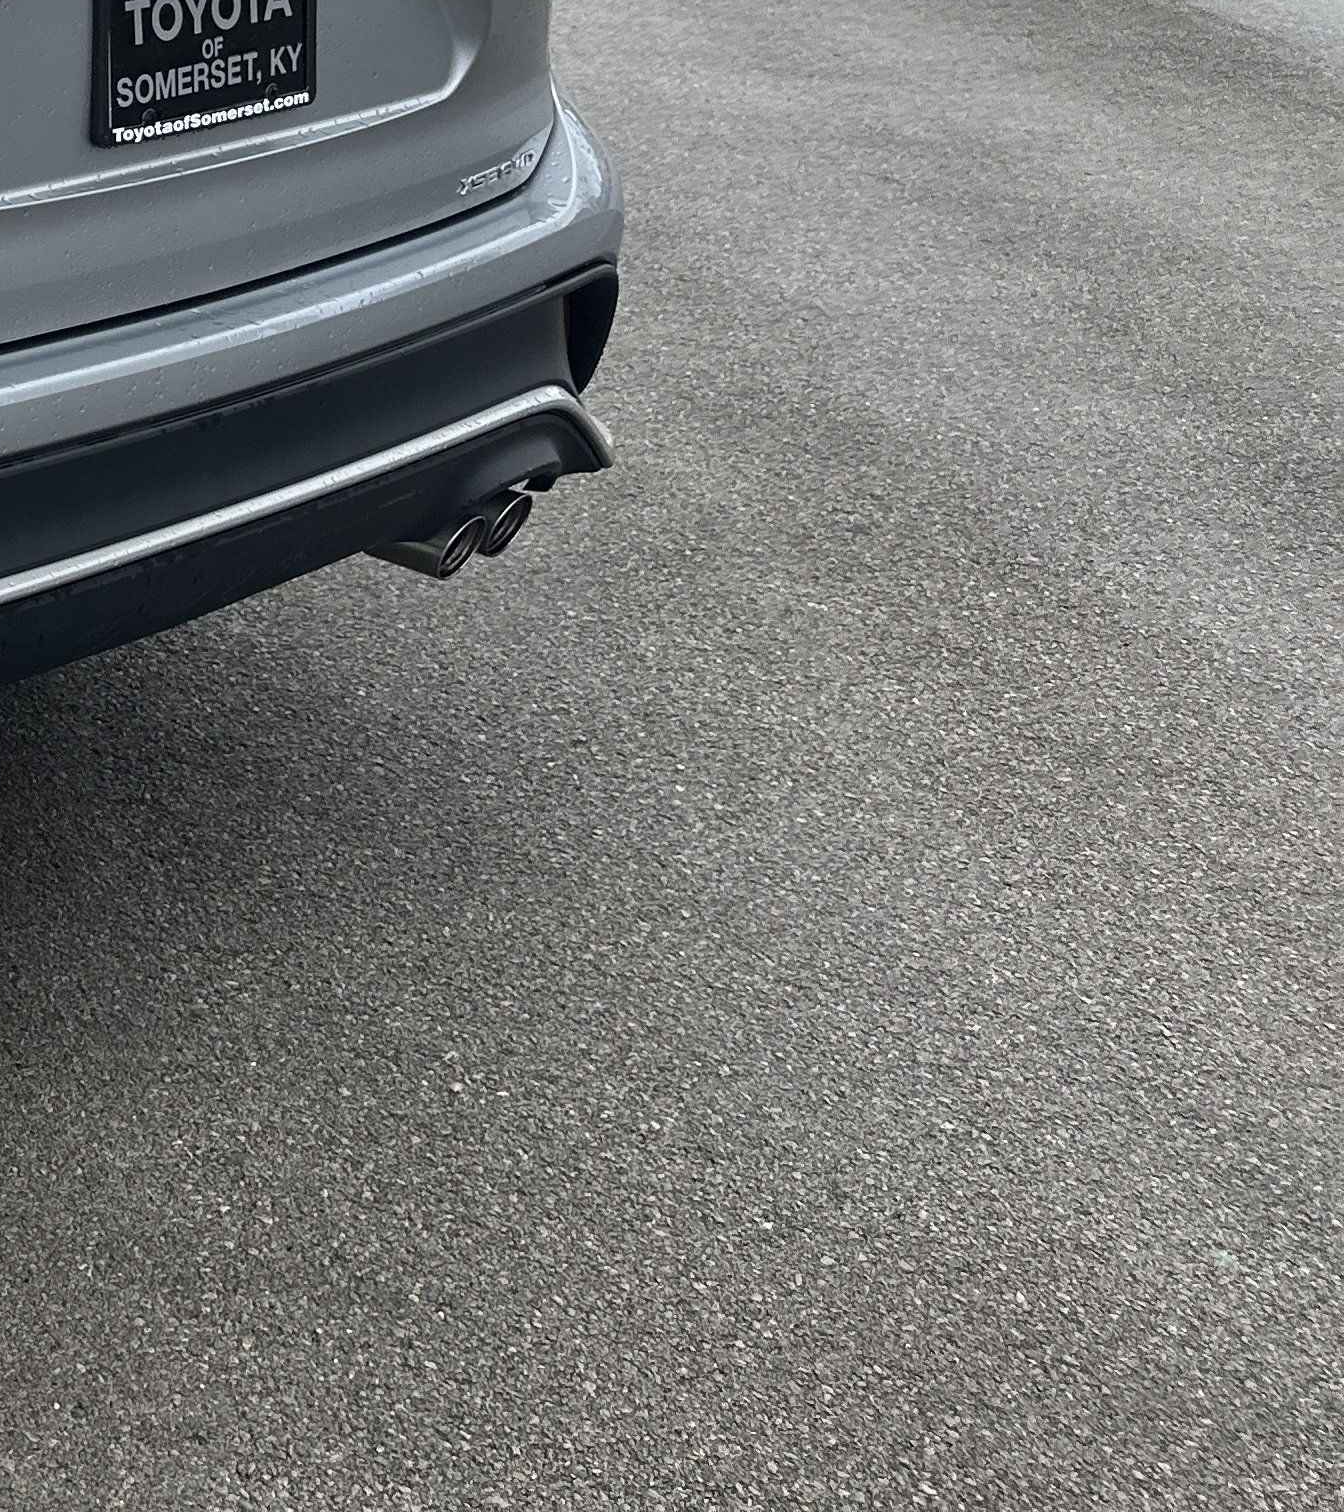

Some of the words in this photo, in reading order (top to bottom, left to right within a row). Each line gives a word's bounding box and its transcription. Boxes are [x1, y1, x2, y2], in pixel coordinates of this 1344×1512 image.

[202, 36, 224, 59] OF
[116, 51, 262, 108] SOMERSET,
[270, 43, 303, 76] KY
[113, 91, 310, 143] ToyotaofSomerset.com
